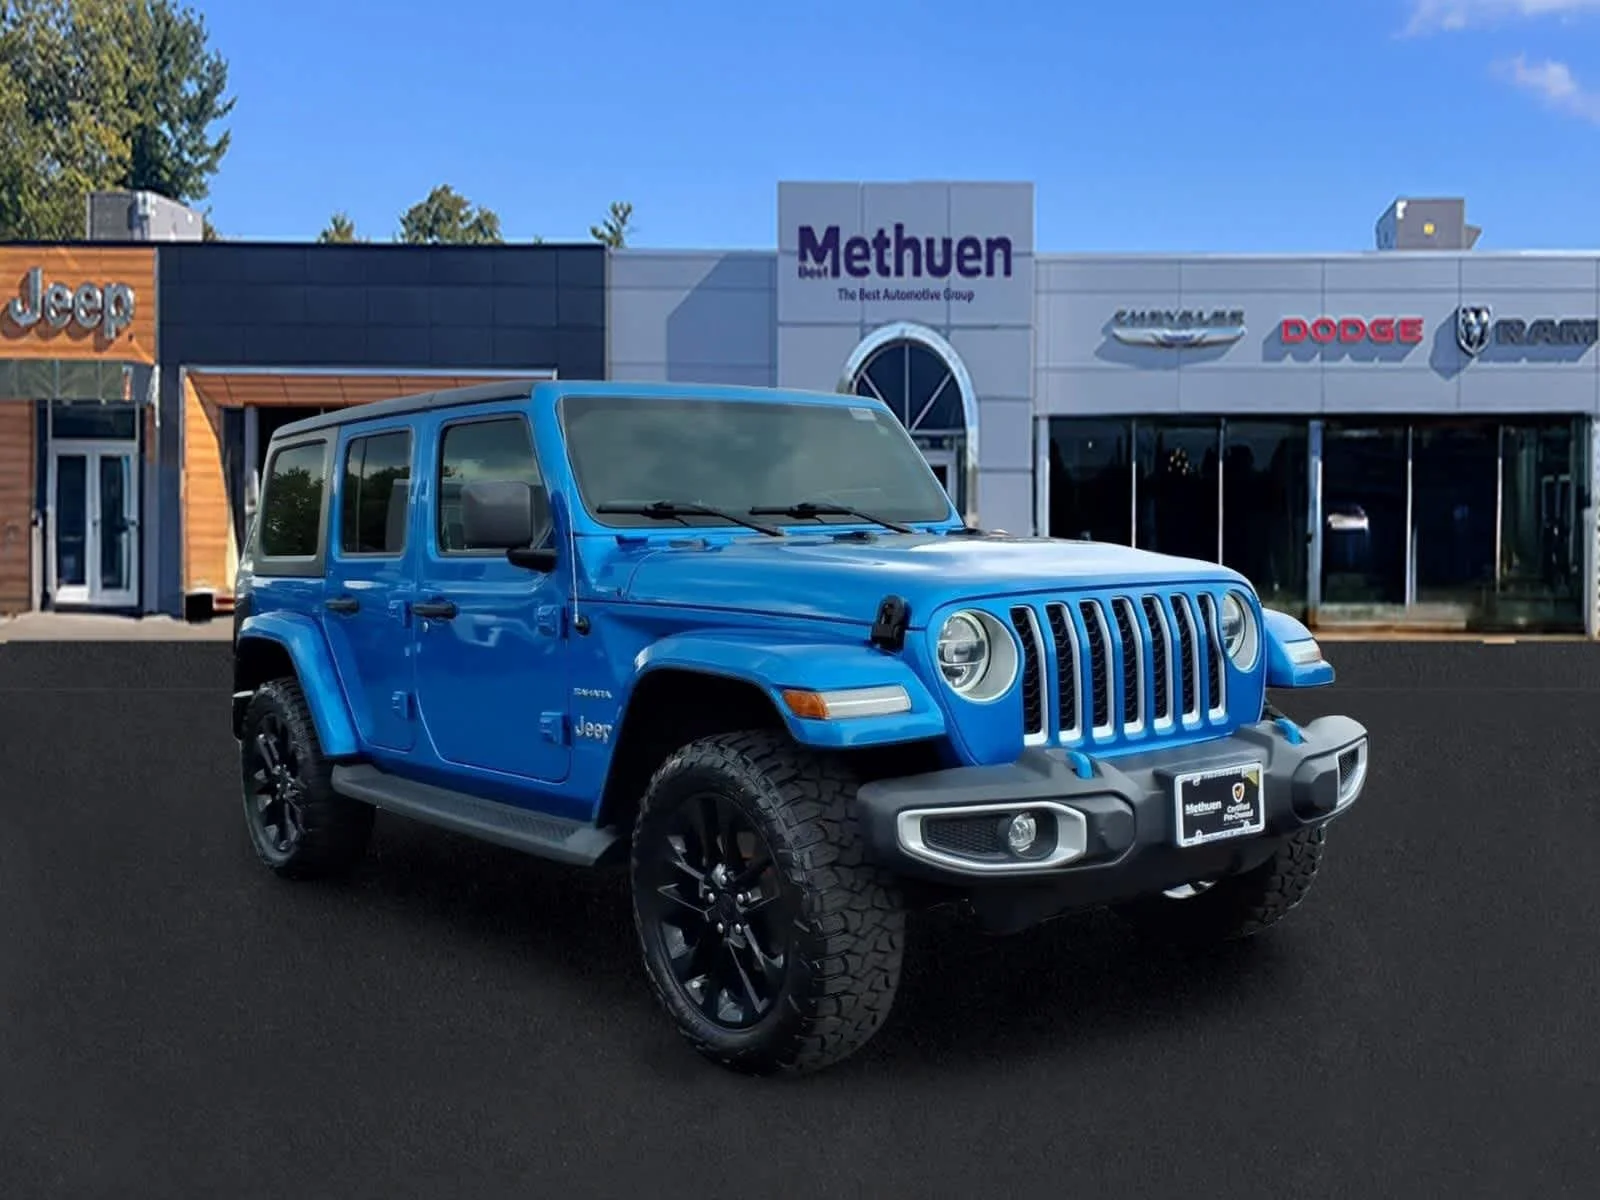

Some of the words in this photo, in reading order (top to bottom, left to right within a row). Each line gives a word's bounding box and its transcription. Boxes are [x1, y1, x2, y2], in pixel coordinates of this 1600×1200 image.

[798, 223, 1012, 278] Methuen
[798, 265, 828, 279] Best
[9, 267, 135, 339] Jeep
[838, 288, 857, 301] The
[859, 288, 880, 301] Best
[882, 288, 941, 301] Automotive
[943, 288, 975, 303] Group
[1281, 317, 1424, 343] DODGE
[1494, 318, 1598, 345] RAM
[574, 715, 613, 745] Jeep
[1185, 800, 1222, 815] Methuen
[1227, 802, 1250, 813] Certified
